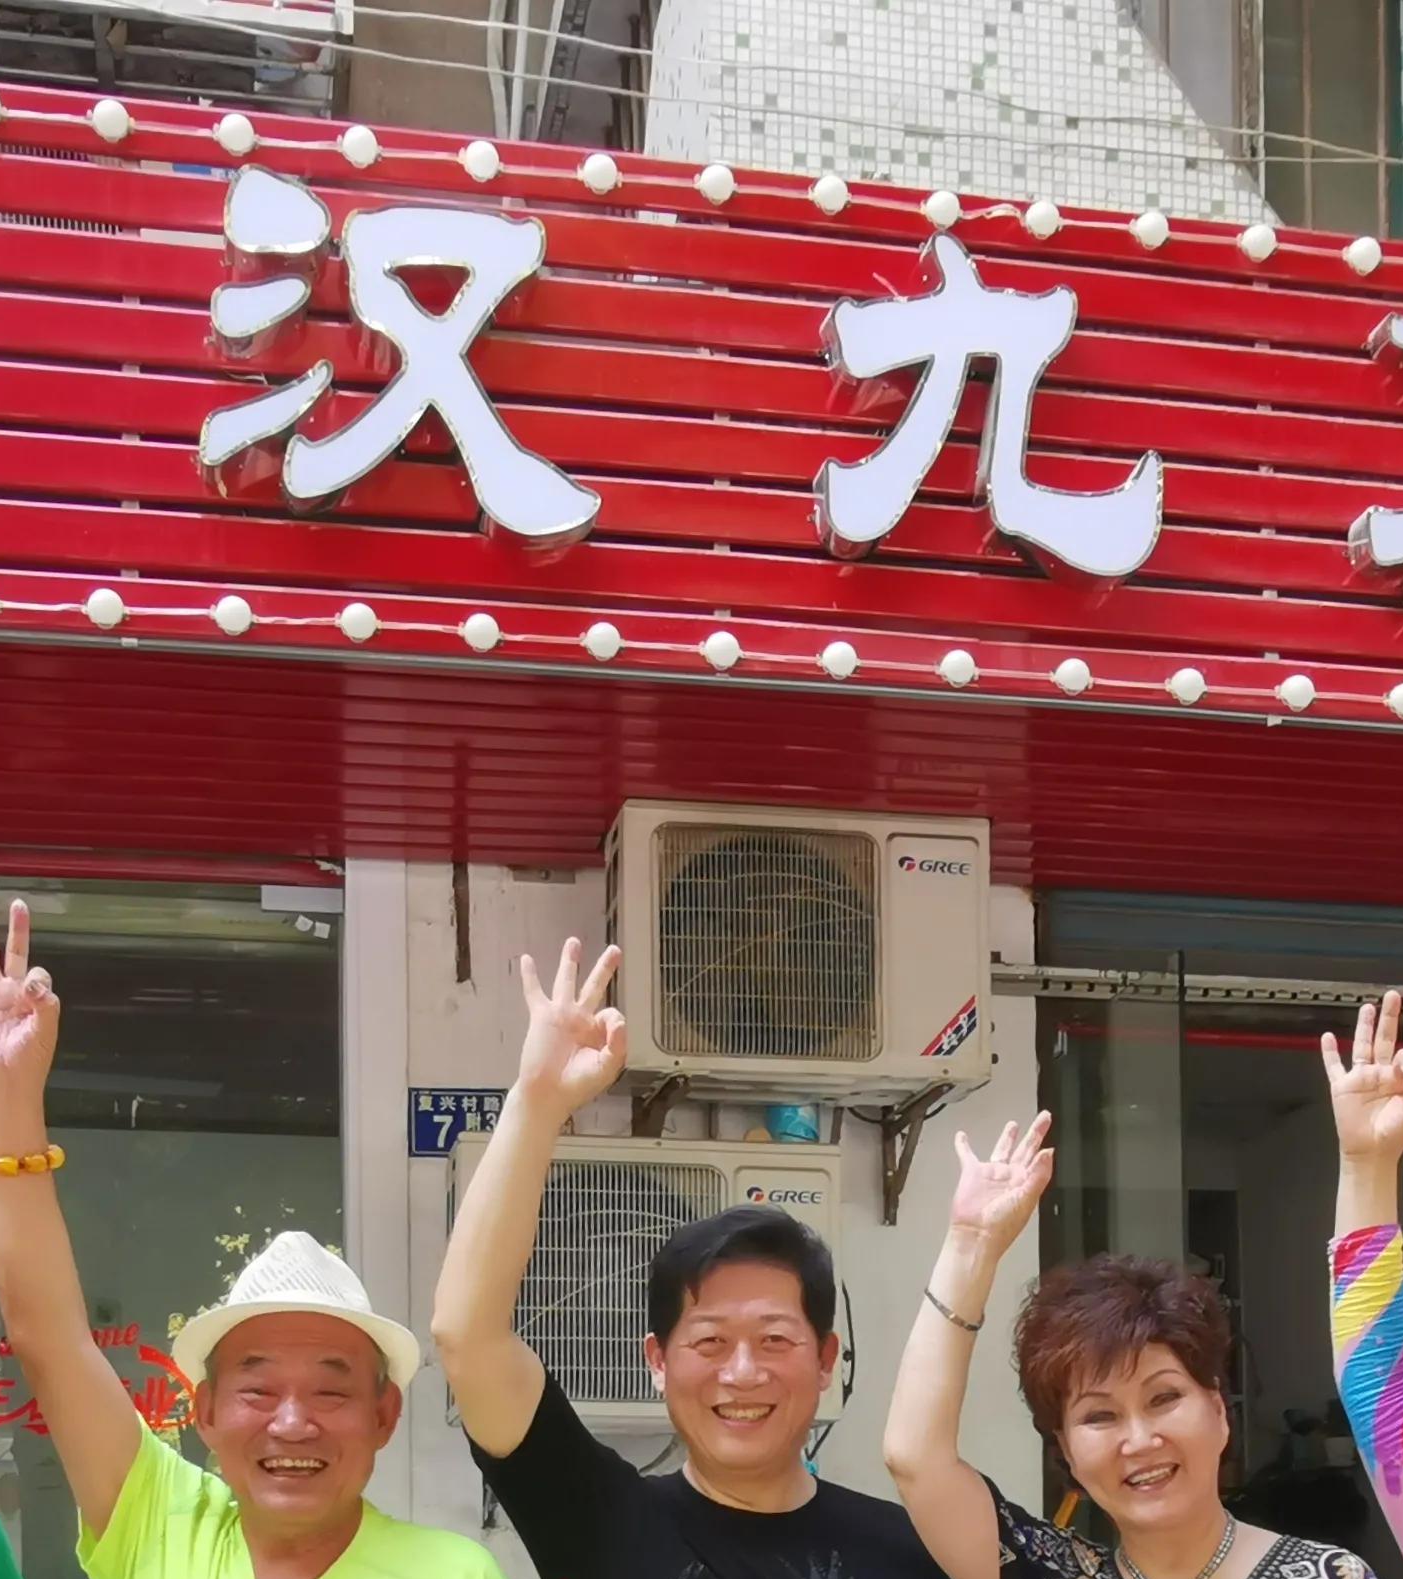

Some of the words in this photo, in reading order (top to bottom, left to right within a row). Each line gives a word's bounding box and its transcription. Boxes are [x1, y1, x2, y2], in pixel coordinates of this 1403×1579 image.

[918, 859, 972, 876] GREE
[433, 1115, 454, 1148] 7
[768, 1189, 824, 1205] GREE
